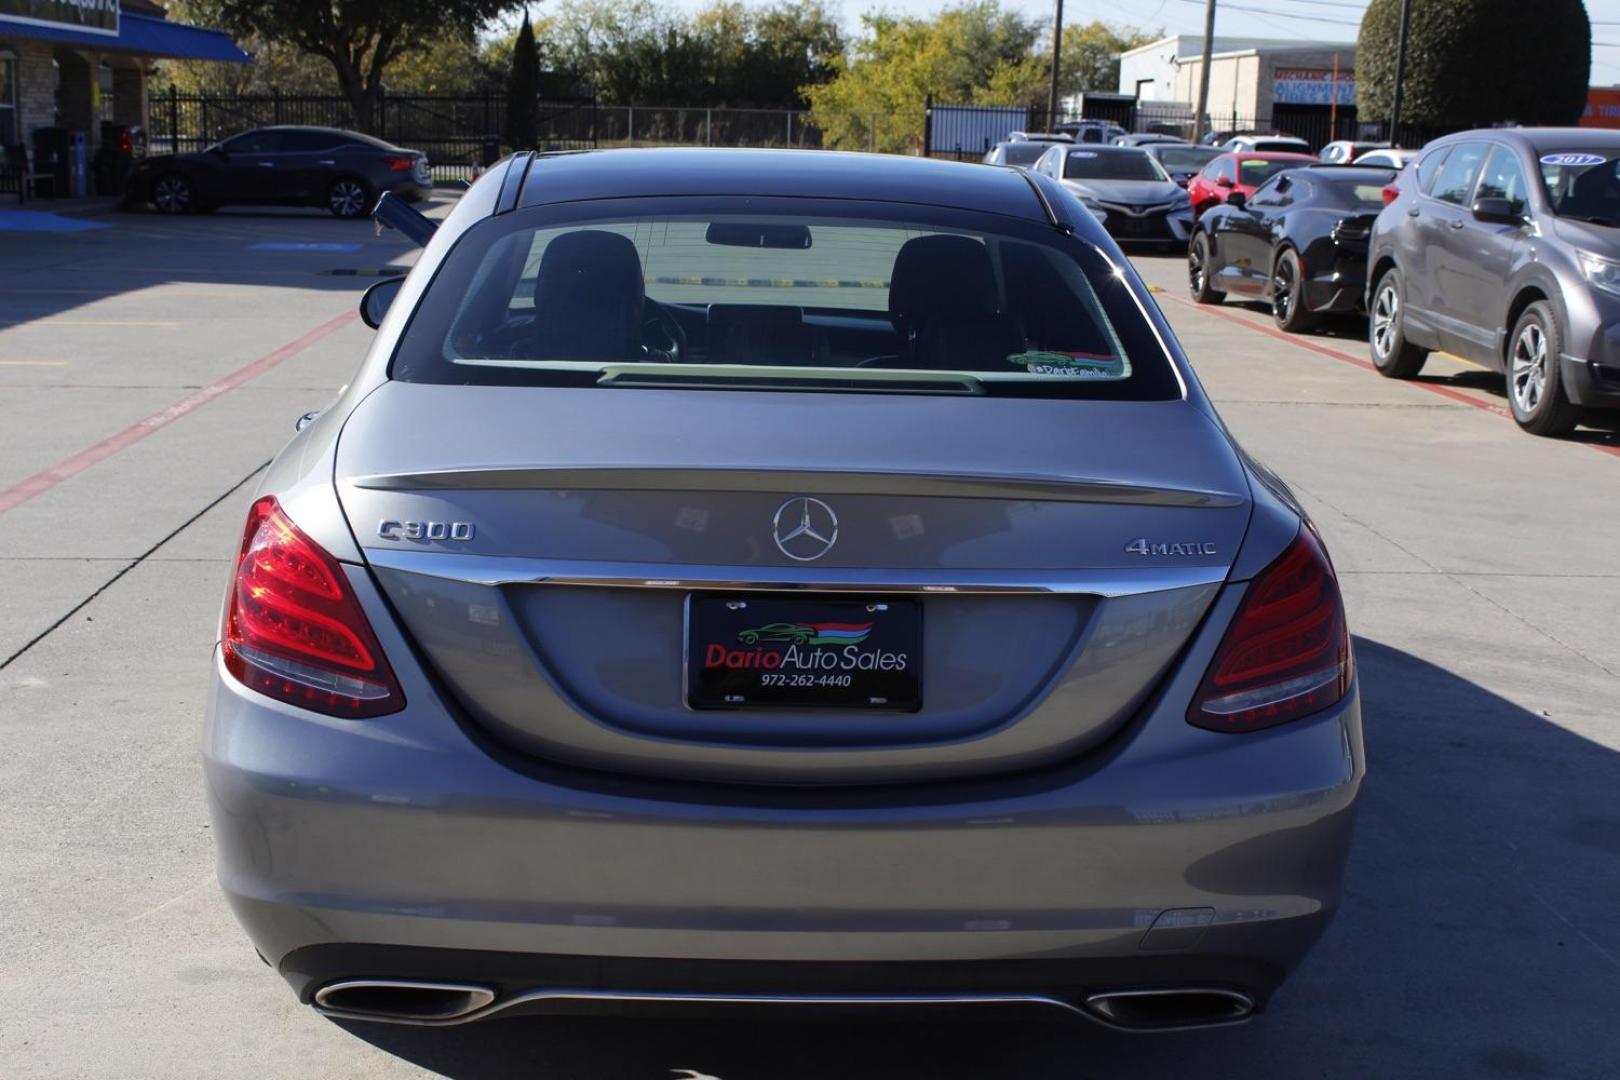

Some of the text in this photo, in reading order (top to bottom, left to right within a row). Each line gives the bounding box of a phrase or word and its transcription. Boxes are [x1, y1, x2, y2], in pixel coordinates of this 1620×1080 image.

[1552, 155, 1596, 165] 2017
[377, 520, 476, 541] C300
[1125, 538, 1217, 556] 4MATIC
[705, 643, 908, 671] Dario Auto Sales
[761, 674, 851, 687] 972-262-4440
